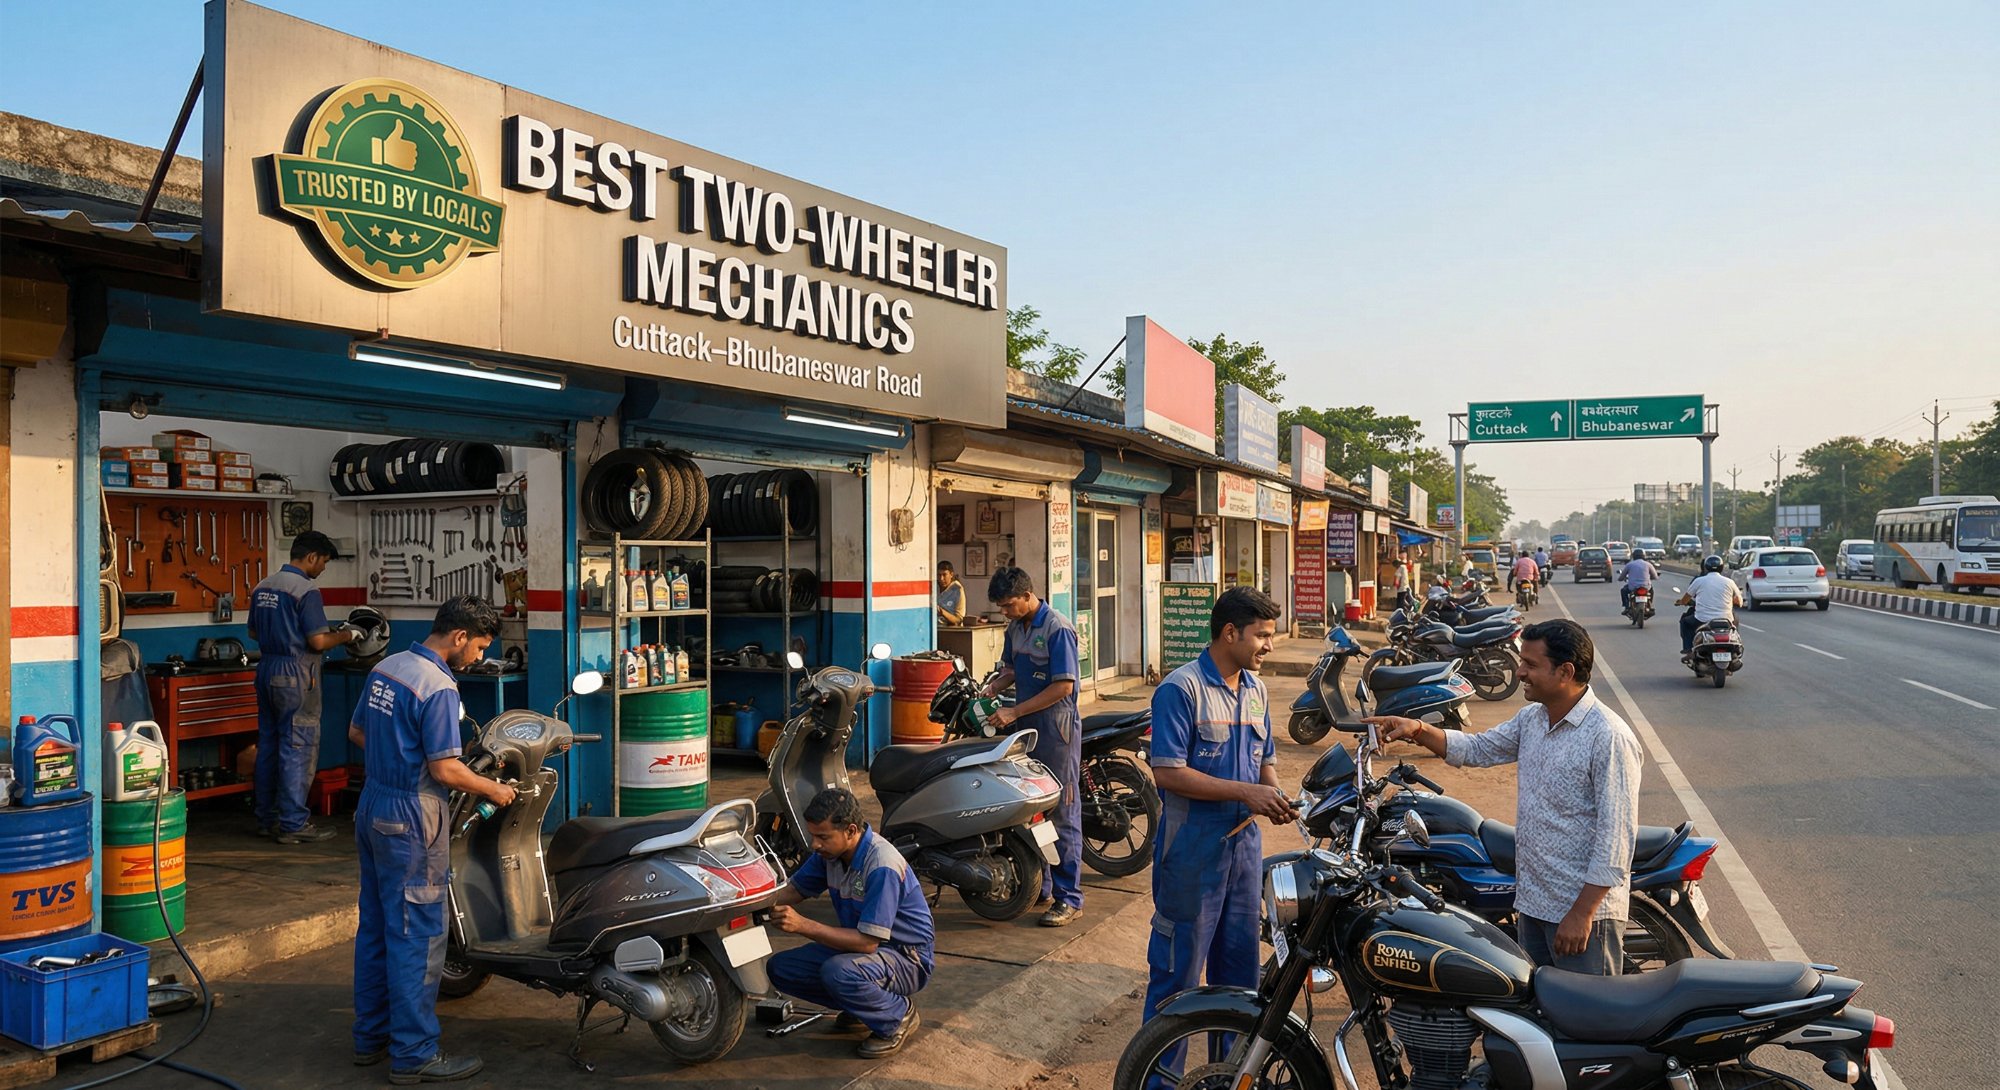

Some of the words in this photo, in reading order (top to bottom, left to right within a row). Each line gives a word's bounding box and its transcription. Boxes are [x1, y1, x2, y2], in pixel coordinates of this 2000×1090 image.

[293, 170, 386, 205] TRUSTED
[393, 184, 418, 212] BY
[423, 192, 493, 234] LOCALS
[517, 114, 668, 220] BEST
[684, 165, 998, 310] TWO-WHEELER
[636, 234, 915, 354] MECHANICS
[877, 366, 922, 397] Road
[1475, 422, 1528, 435] Cuttack
[1582, 420, 1674, 432] Bhubaneswar
[12, 880, 76, 911] TVS
[1374, 955, 1421, 973] ENFIELD
